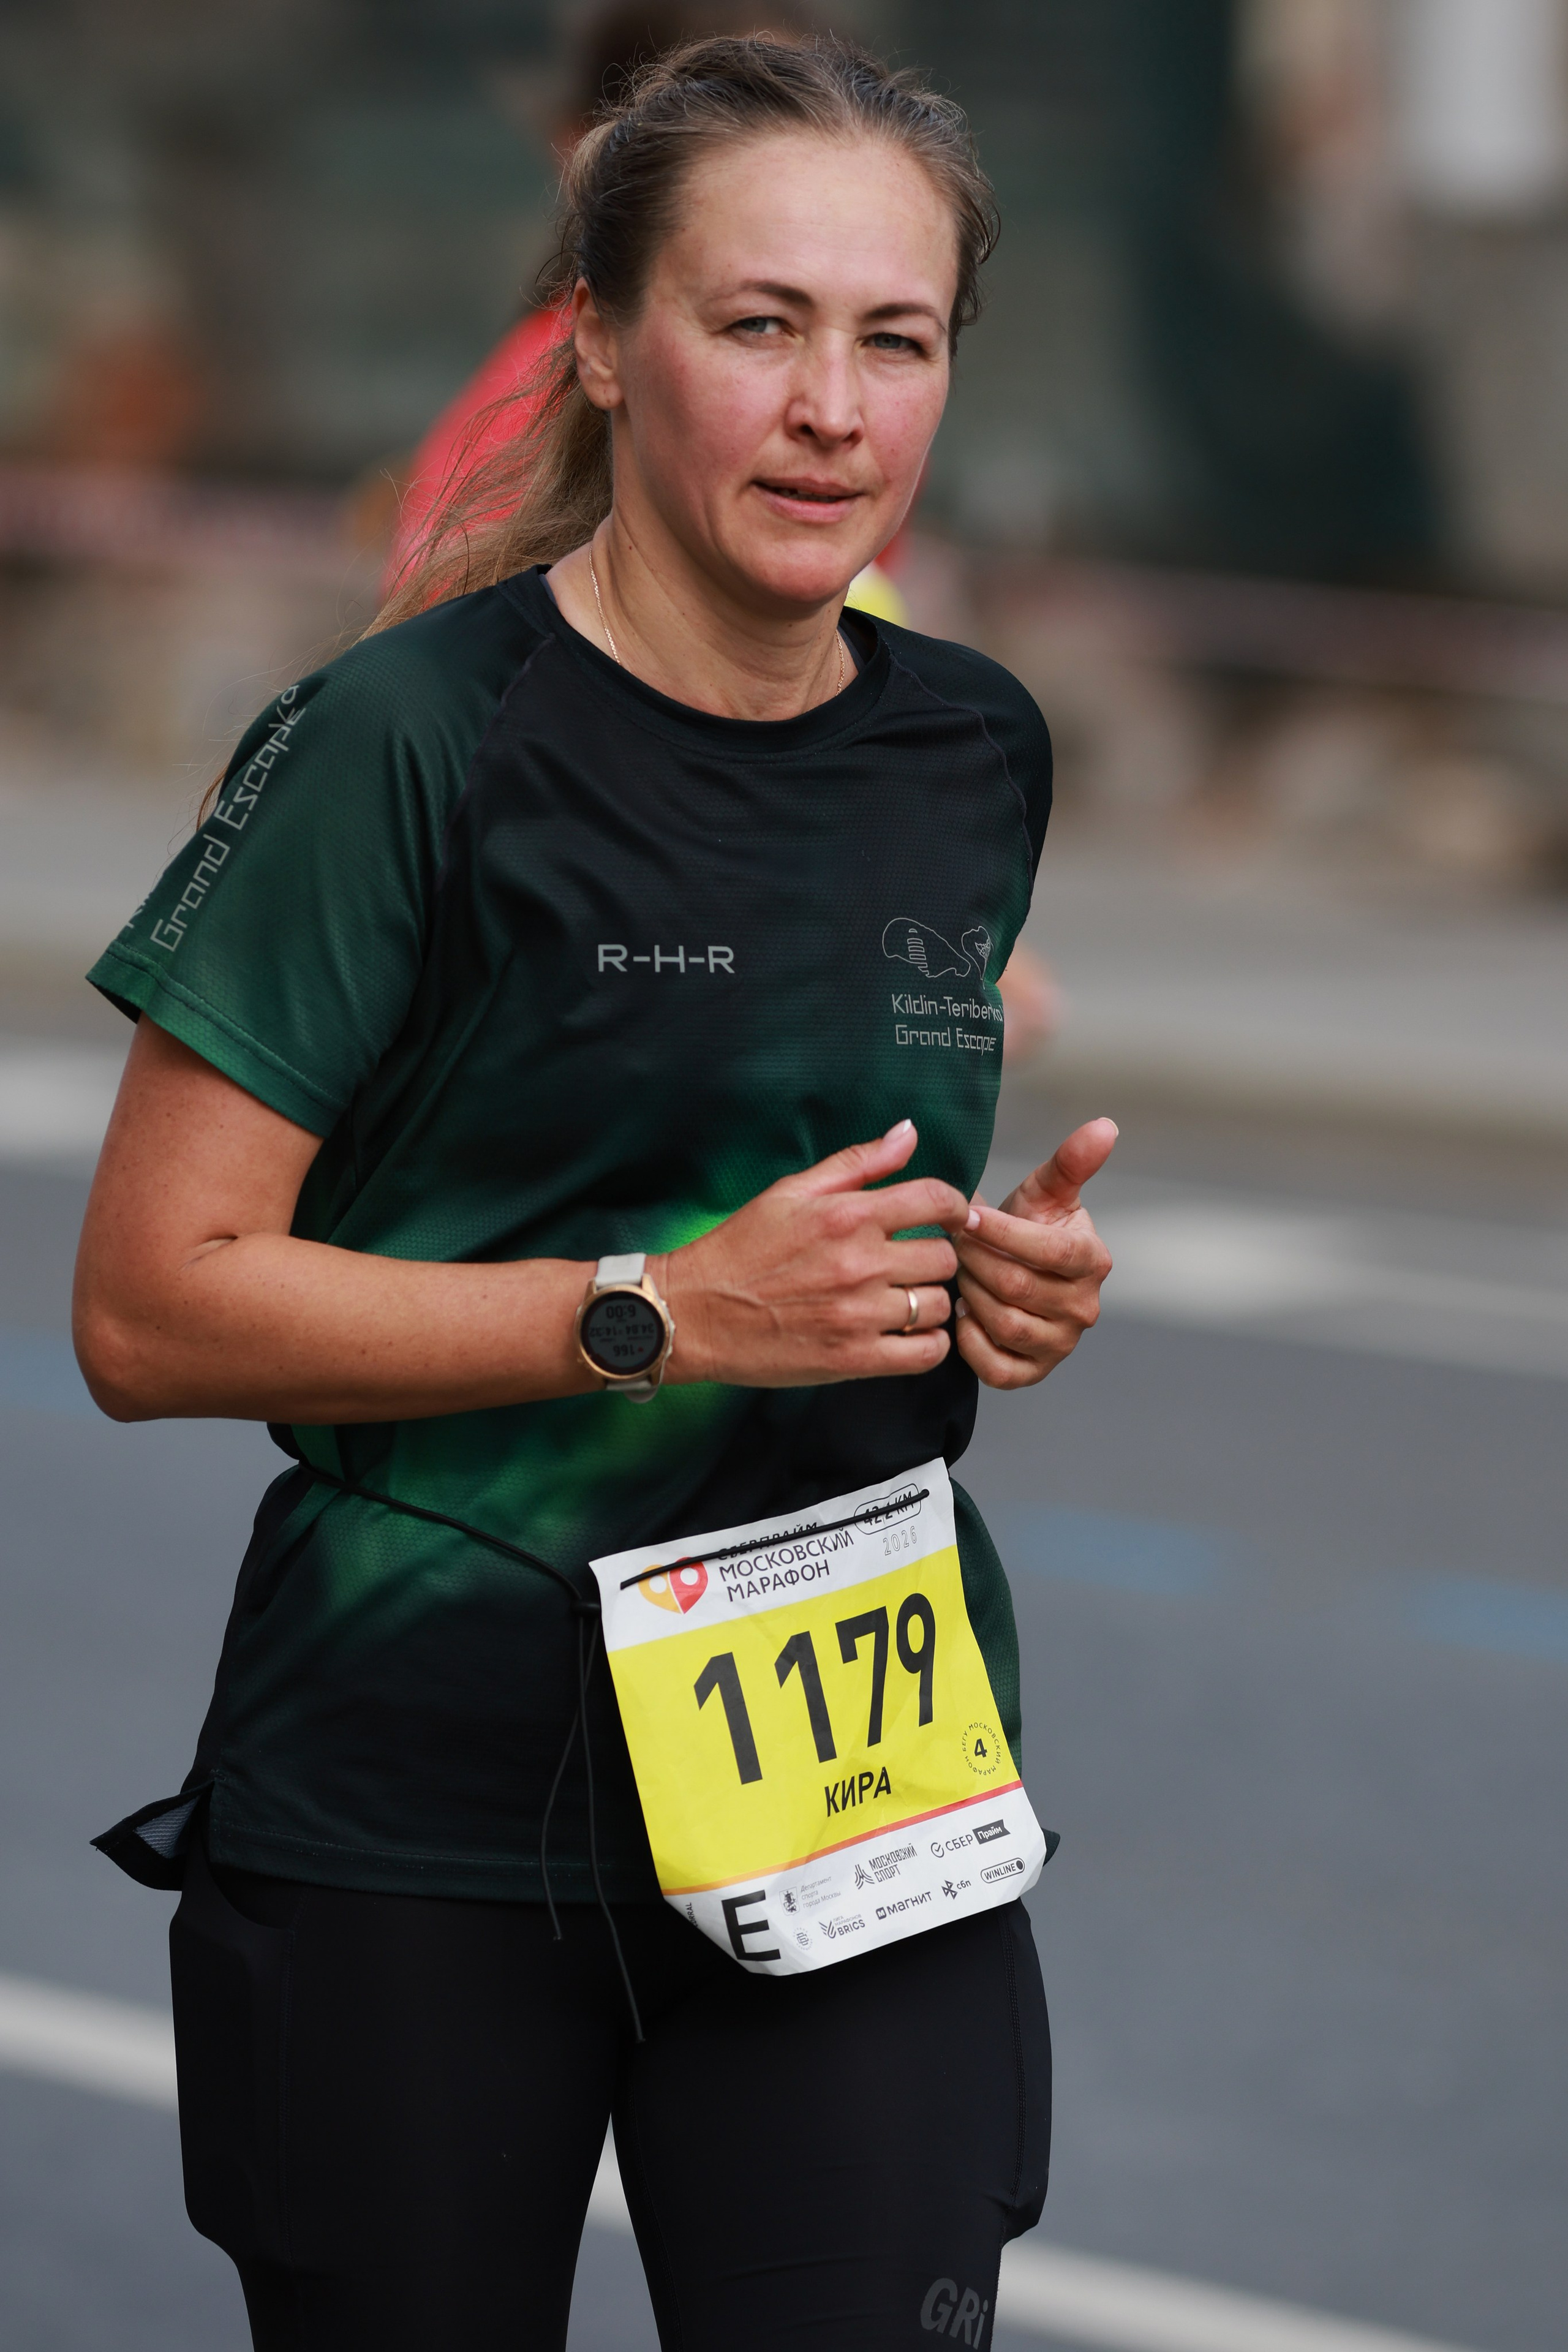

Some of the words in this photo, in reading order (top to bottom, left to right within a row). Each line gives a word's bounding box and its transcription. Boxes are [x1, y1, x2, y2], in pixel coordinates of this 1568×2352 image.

[150, 834, 230, 952] Grand
[597, 943, 736, 974] R-H-R
[895, 1024, 951, 1047] Grand
[956, 1028, 997, 1056] Escape
[718, 1527, 854, 1582] МОСКОВСКИЙ
[883, 1525, 918, 1556] 2026
[726, 1559, 831, 1602] МАРАФОН
[693, 1593, 936, 1785] 1179
[968, 1722, 1001, 1764] МОСКОВСКИЙ
[974, 1738, 987, 1758] 4
[965, 1755, 997, 1776] МАРАФОН
[824, 1766, 892, 1817] КИРА
[945, 1834, 973, 1851] СБЕР
[977, 1826, 1003, 1840] Прайм
[869, 1842, 918, 1871] МОСКОВСКИЙ
[984, 1863, 1016, 1880] WINLINE
[874, 1864, 901, 1883] СПОРТ
[956, 1880, 972, 1890] сбп
[722, 1889, 781, 1961] E
[837, 1920, 865, 1936] BRICS
